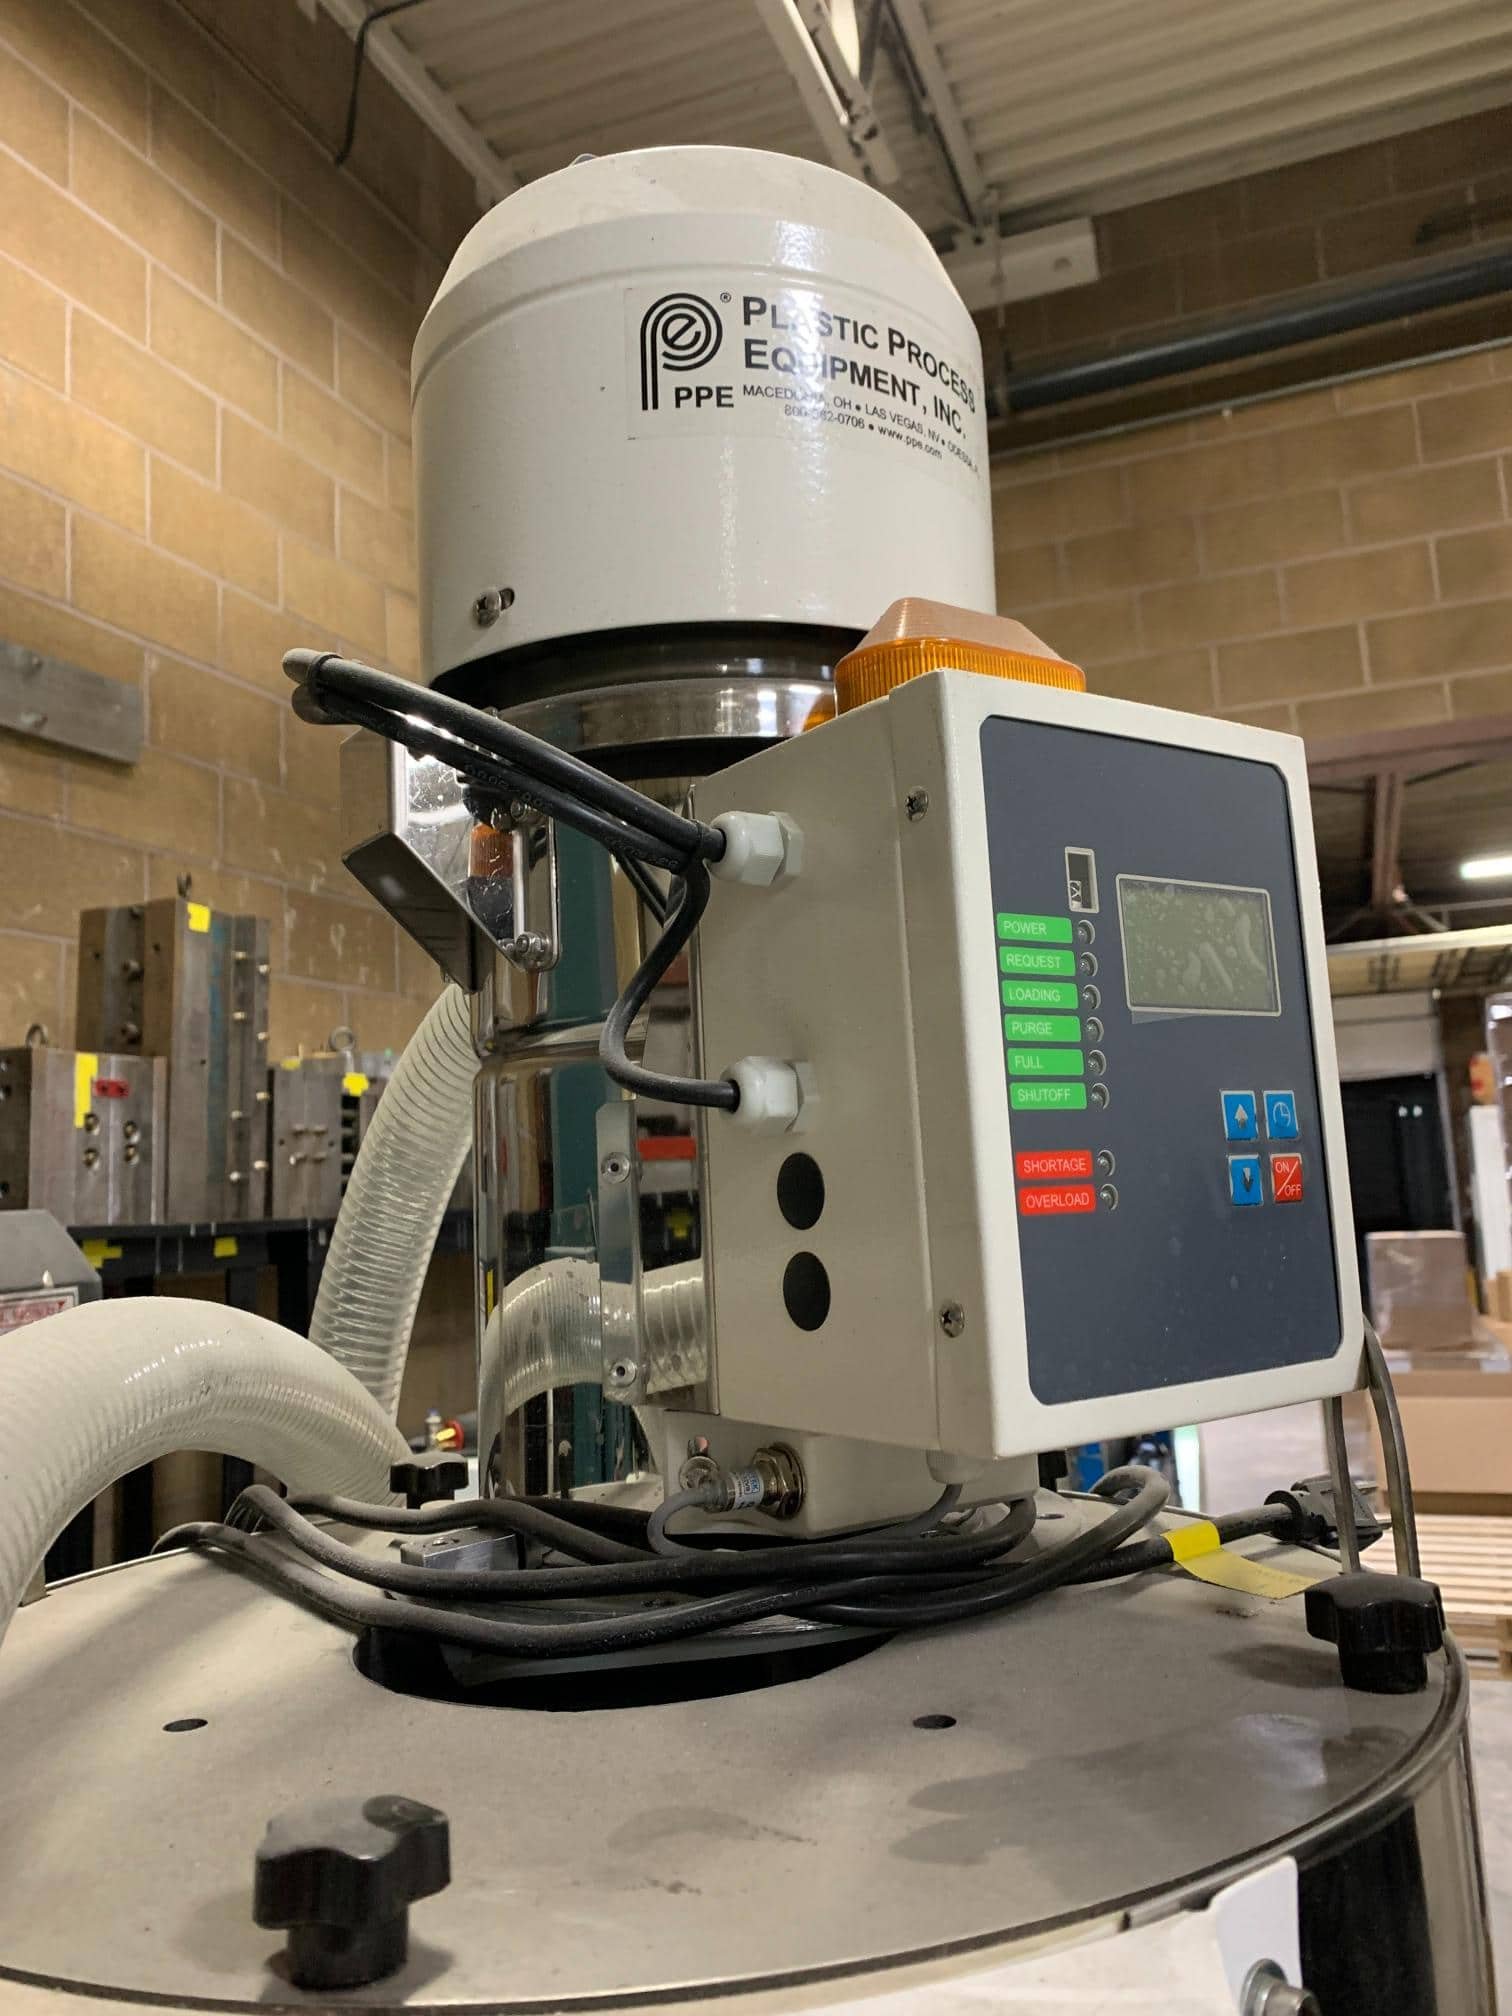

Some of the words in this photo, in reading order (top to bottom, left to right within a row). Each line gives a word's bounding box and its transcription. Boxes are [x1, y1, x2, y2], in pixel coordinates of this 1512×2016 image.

[743, 295, 879, 350] PLSTIC
[887, 327, 976, 414] PROCESS
[674, 386, 735, 409] PPE
[833, 396, 852, 410] OH
[865, 402, 887, 421] LAS
[933, 395, 967, 440] INC.
[1003, 920, 1047, 936] POWER
[1006, 953, 1061, 970] REQUEST
[1009, 987, 1061, 1003] LOADING
[1011, 1021, 1053, 1037] PURGE
[1014, 1055, 1044, 1070] FULL
[1017, 1087, 1071, 1103] SHUTOFF
[1023, 1157, 1087, 1175] SHORTAGE
[1275, 1160, 1290, 1174] ON
[1284, 1183, 1303, 1198] OFF
[1024, 1192, 1090, 1209] OVERLOAD
